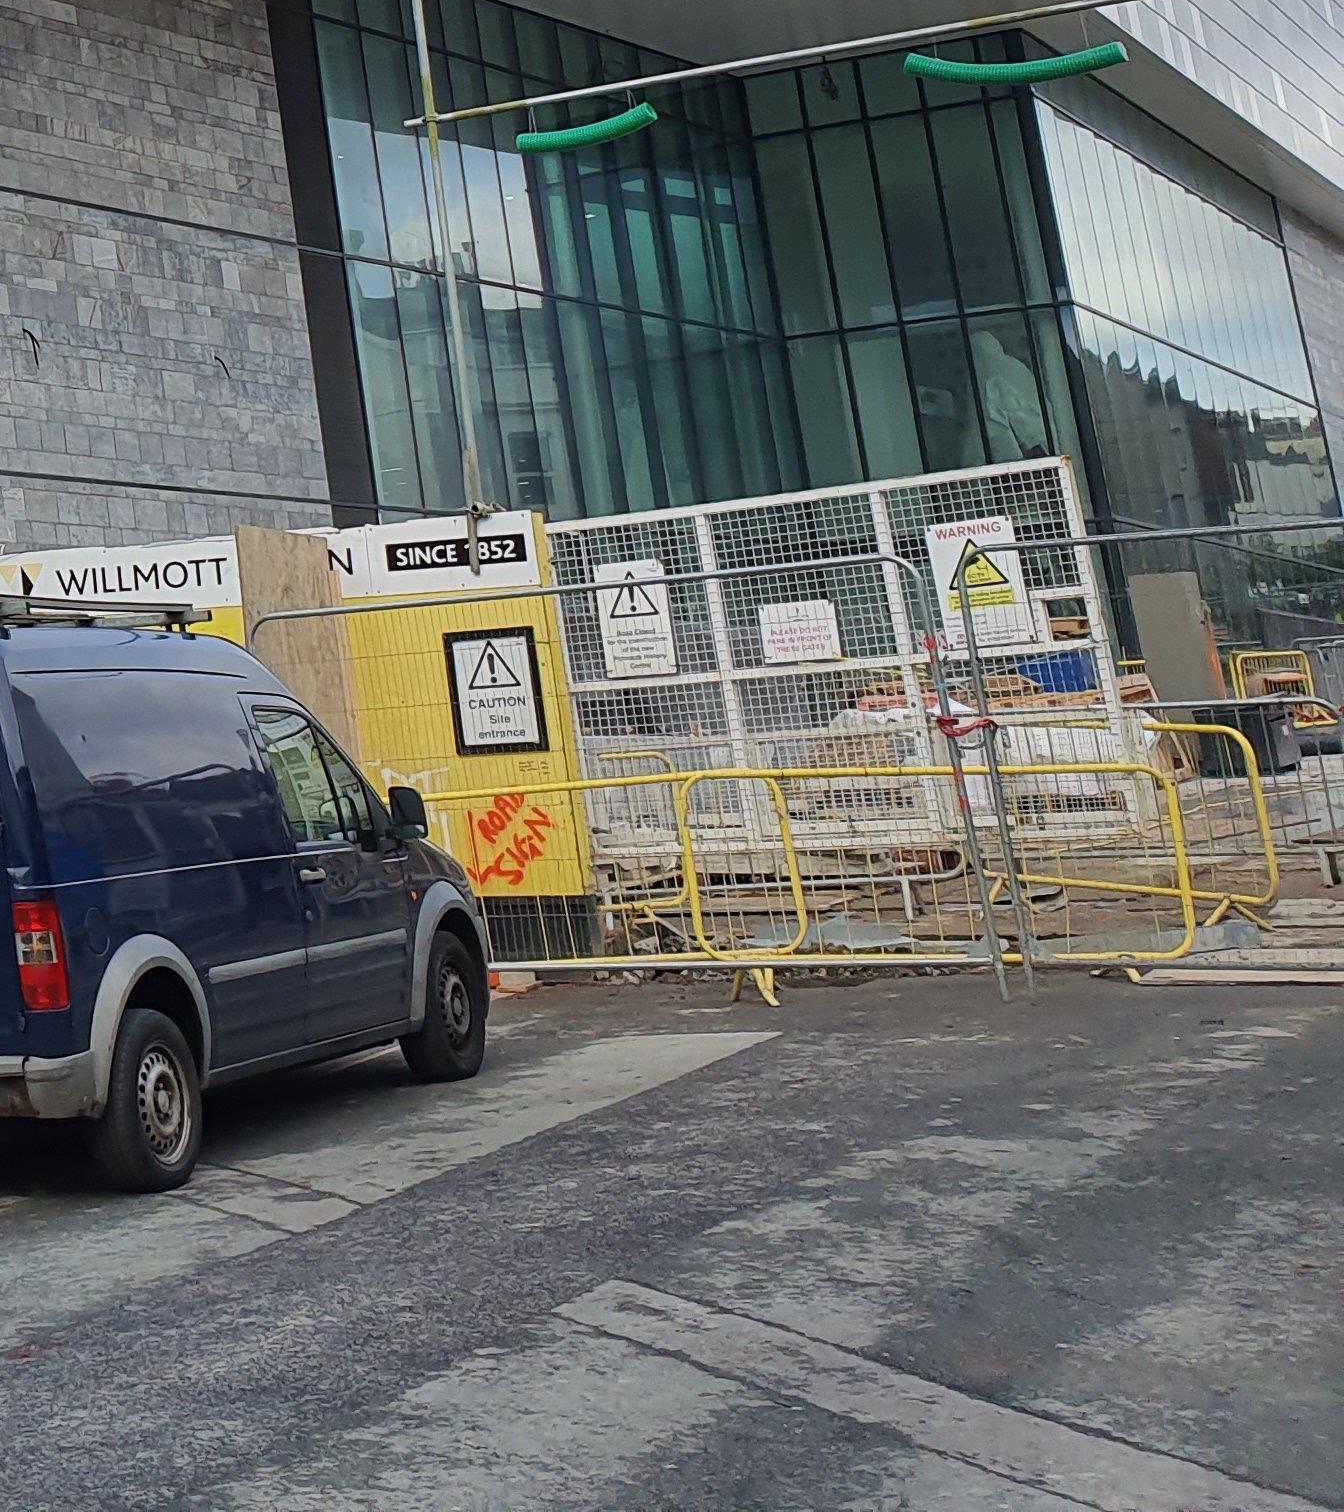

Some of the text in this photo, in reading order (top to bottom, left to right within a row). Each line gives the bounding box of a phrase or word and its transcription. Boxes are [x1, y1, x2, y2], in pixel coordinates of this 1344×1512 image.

[934, 521, 1002, 541] WARNING
[55, 539, 517, 596] WILLMOTT SINCE 852
[468, 695, 527, 710] CAUTION
[489, 713, 511, 725] Site
[478, 728, 526, 739] entrance
